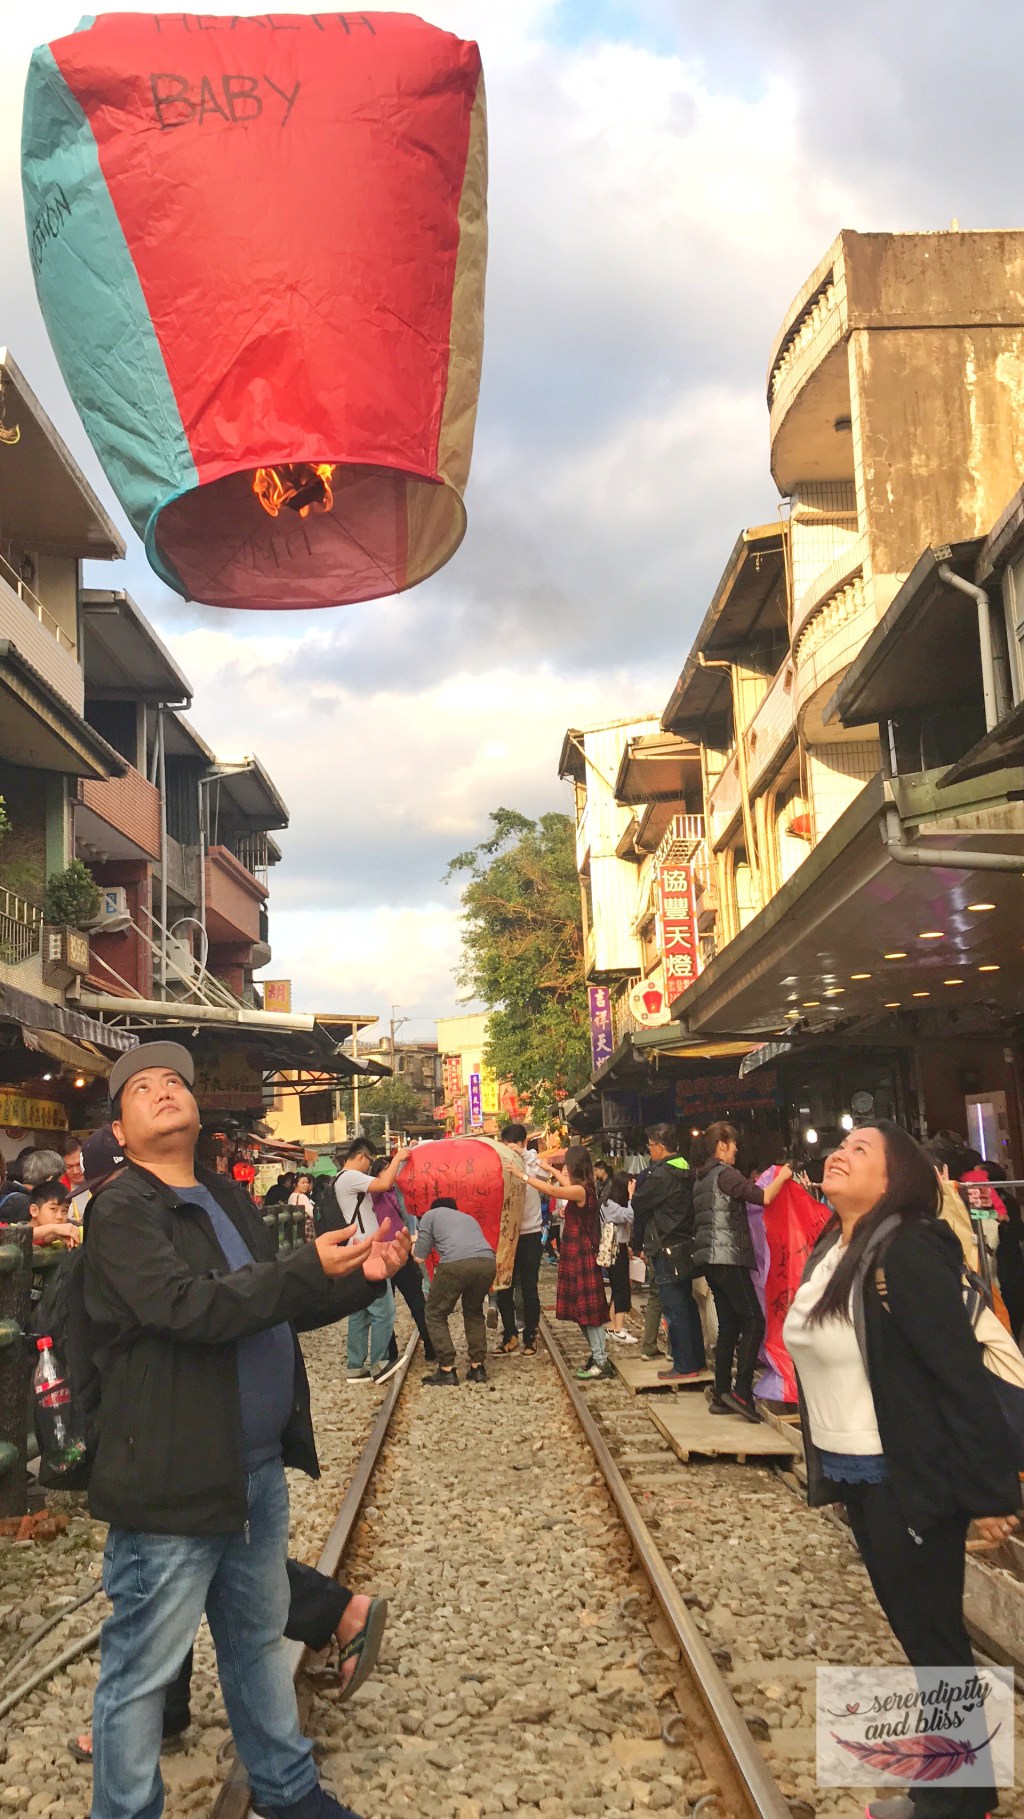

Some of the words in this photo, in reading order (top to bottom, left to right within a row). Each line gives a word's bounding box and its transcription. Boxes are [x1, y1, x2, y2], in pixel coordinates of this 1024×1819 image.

[149, 72, 302, 130] BABY
[661, 869, 693, 978] 協豐天燈
